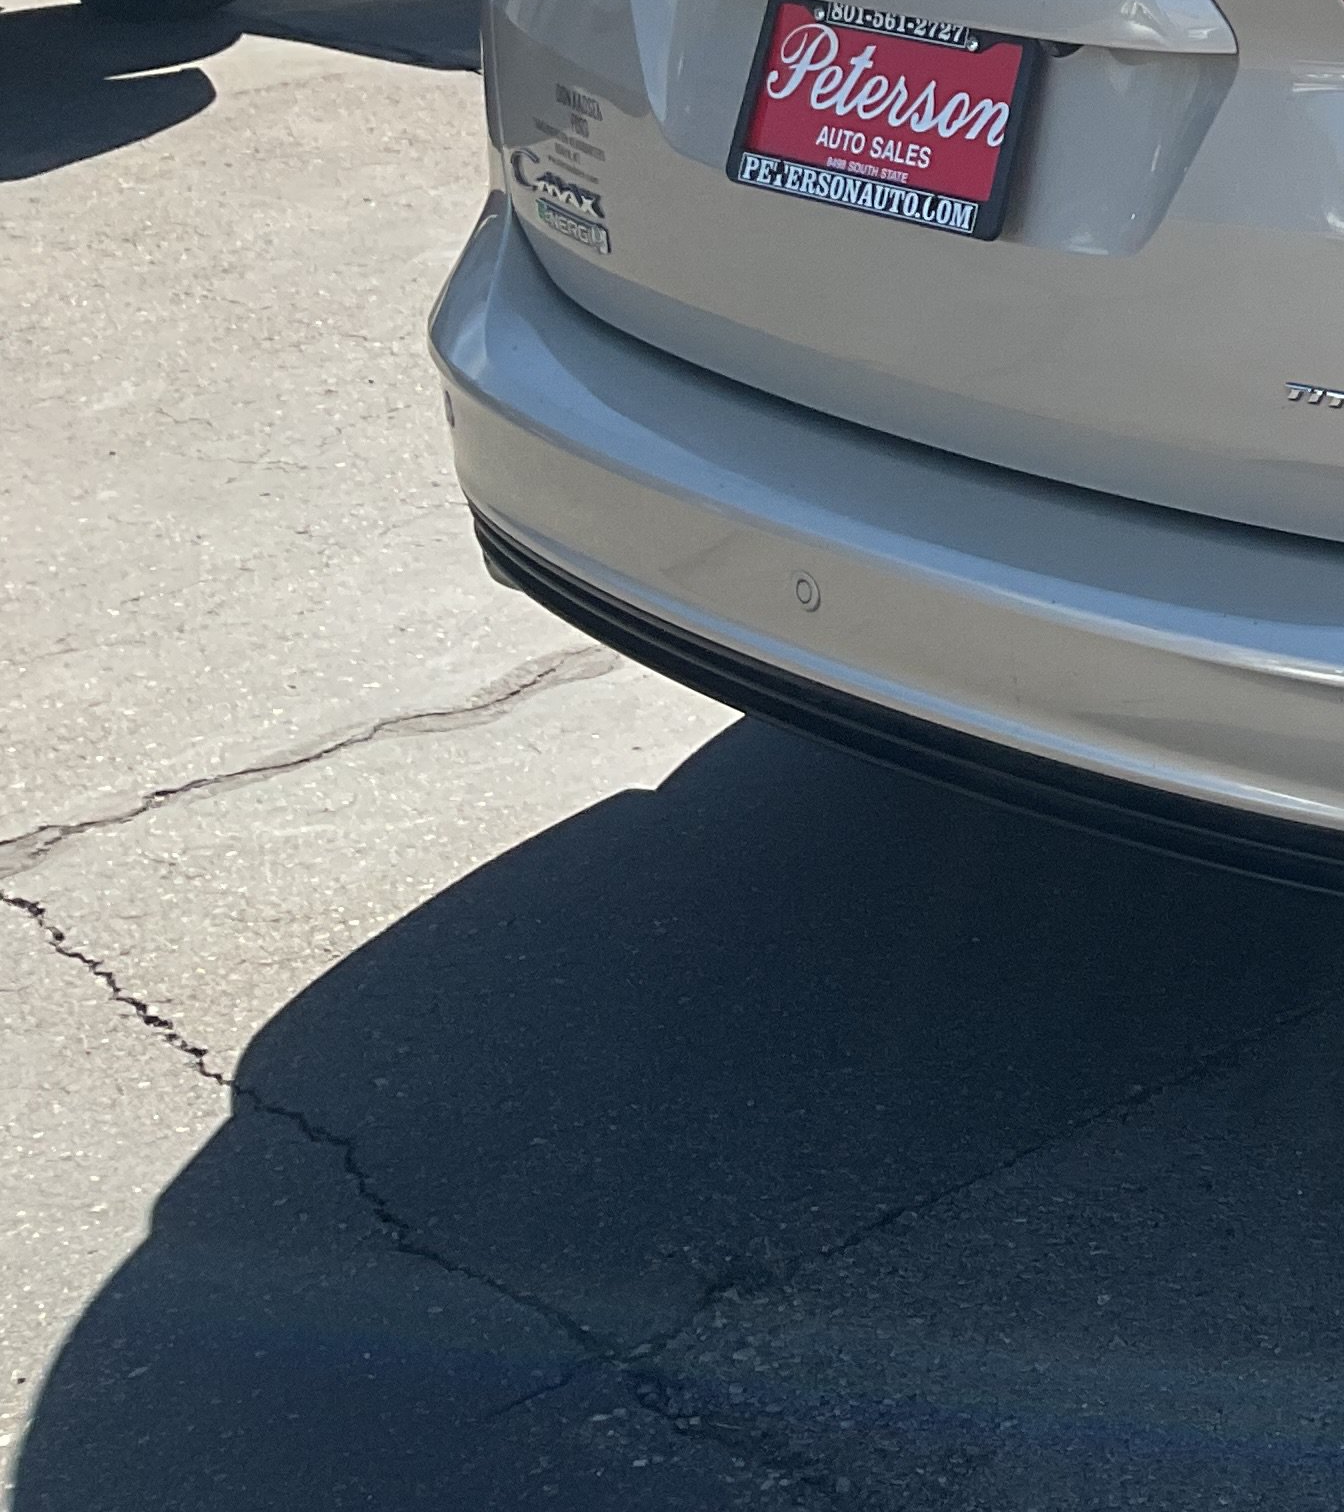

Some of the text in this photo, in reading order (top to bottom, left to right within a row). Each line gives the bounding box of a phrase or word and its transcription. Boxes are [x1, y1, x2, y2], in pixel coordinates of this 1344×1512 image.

[766, 22, 1011, 148] Peterson
[815, 125, 933, 169] AUTO SALES
[848, 160, 879, 177] SOUTH
[880, 167, 909, 184] STATE
